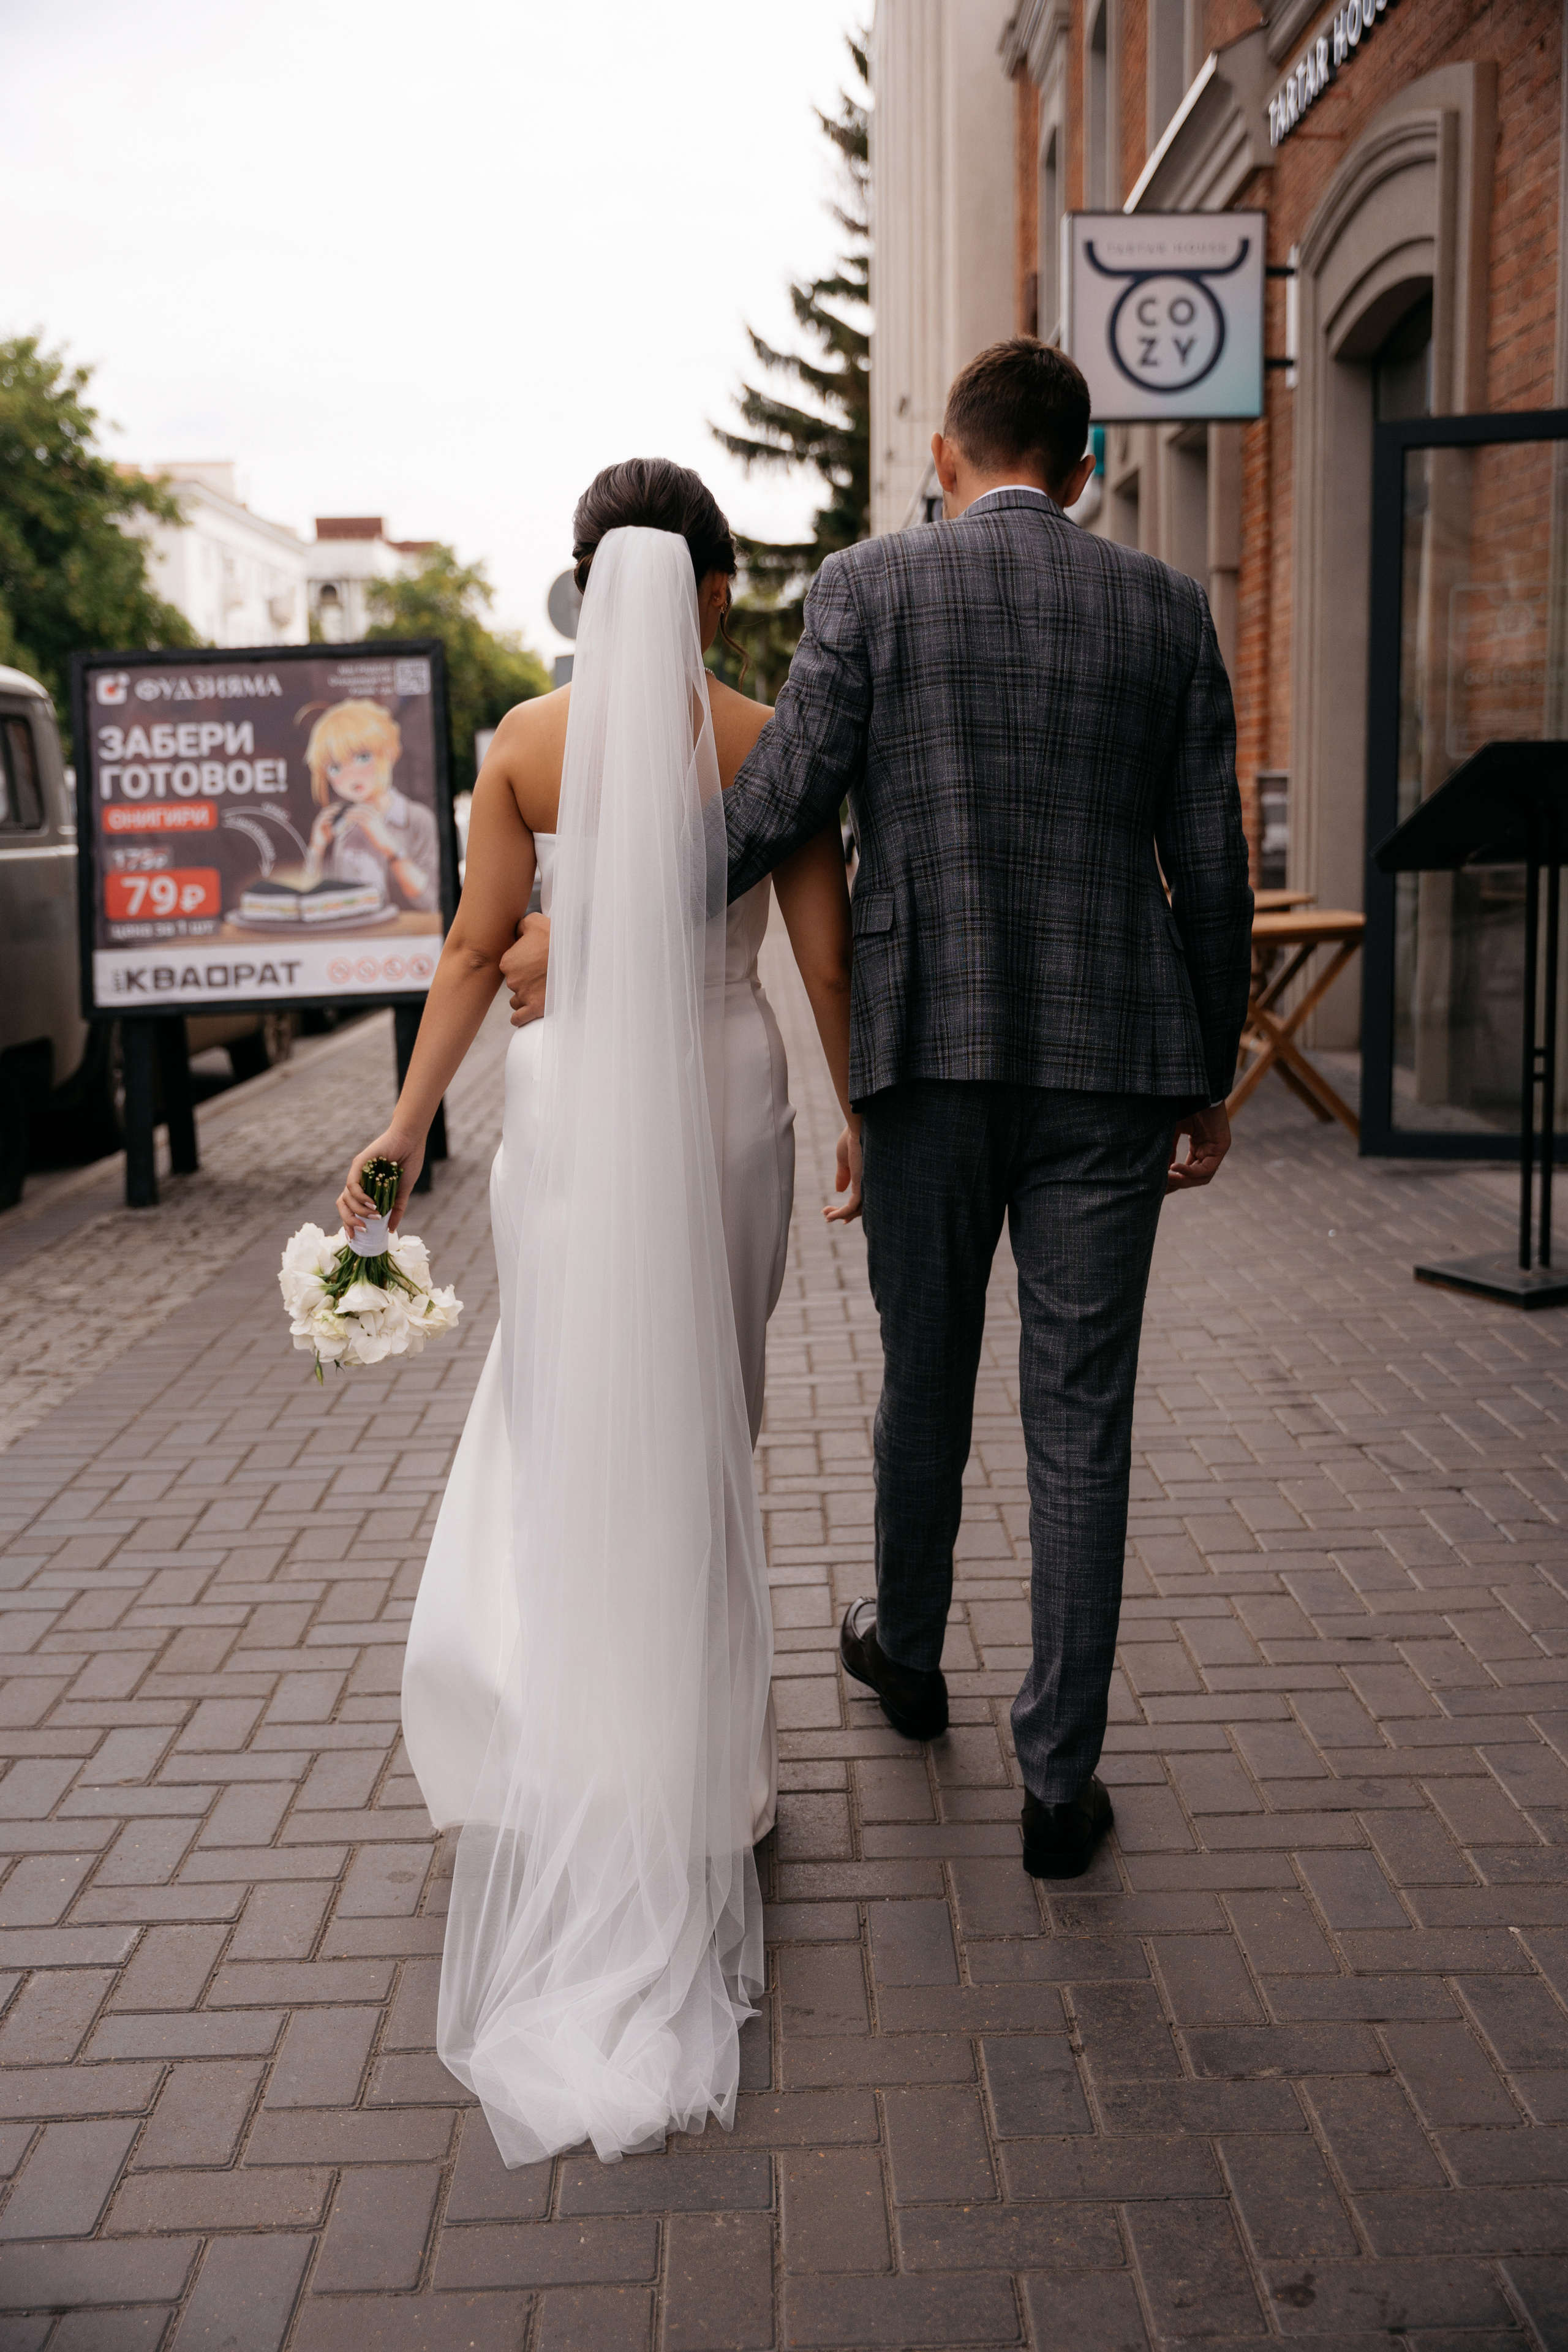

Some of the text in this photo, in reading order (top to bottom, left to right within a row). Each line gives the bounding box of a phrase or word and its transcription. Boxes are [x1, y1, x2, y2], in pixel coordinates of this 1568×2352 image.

[1268, 0, 1387, 148] TARTAR HOU
[1137, 296, 1195, 326] CO
[1139, 336, 1195, 366] ZY
[134, 674, 283, 701] ФУДЗИЯМА
[98, 720, 254, 761] ЗАБЕРИ
[99, 758, 288, 799] ГОТОВОЕ!
[108, 805, 210, 829] ОНИГИРИ
[111, 924, 153, 940] цена
